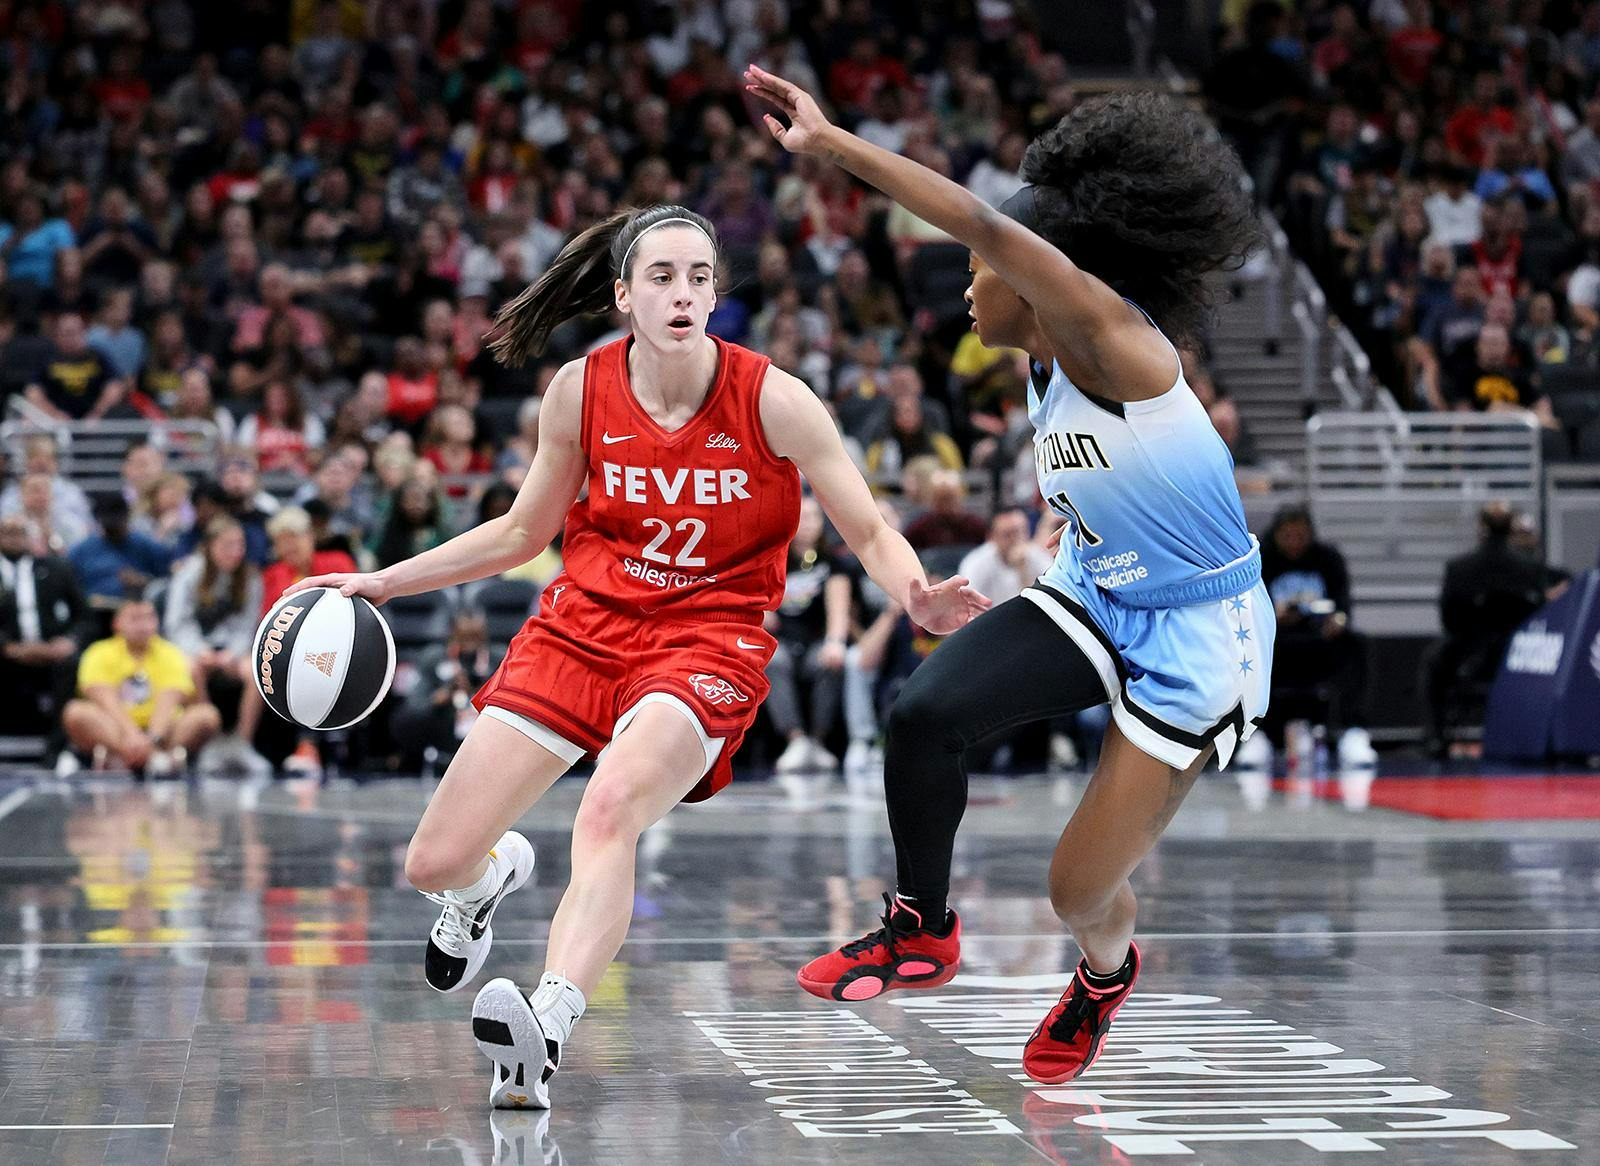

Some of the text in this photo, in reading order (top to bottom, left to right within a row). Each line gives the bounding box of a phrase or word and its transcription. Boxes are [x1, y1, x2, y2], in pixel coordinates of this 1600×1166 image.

[705, 432, 741, 453] Lilly
[1036, 432, 1112, 475] TOWN
[602, 461, 752, 505] FEVER
[642, 518, 706, 567] 22
[261, 605, 305, 695] Wilson
[682, 1009, 1023, 1138] FIELDHOUSE
